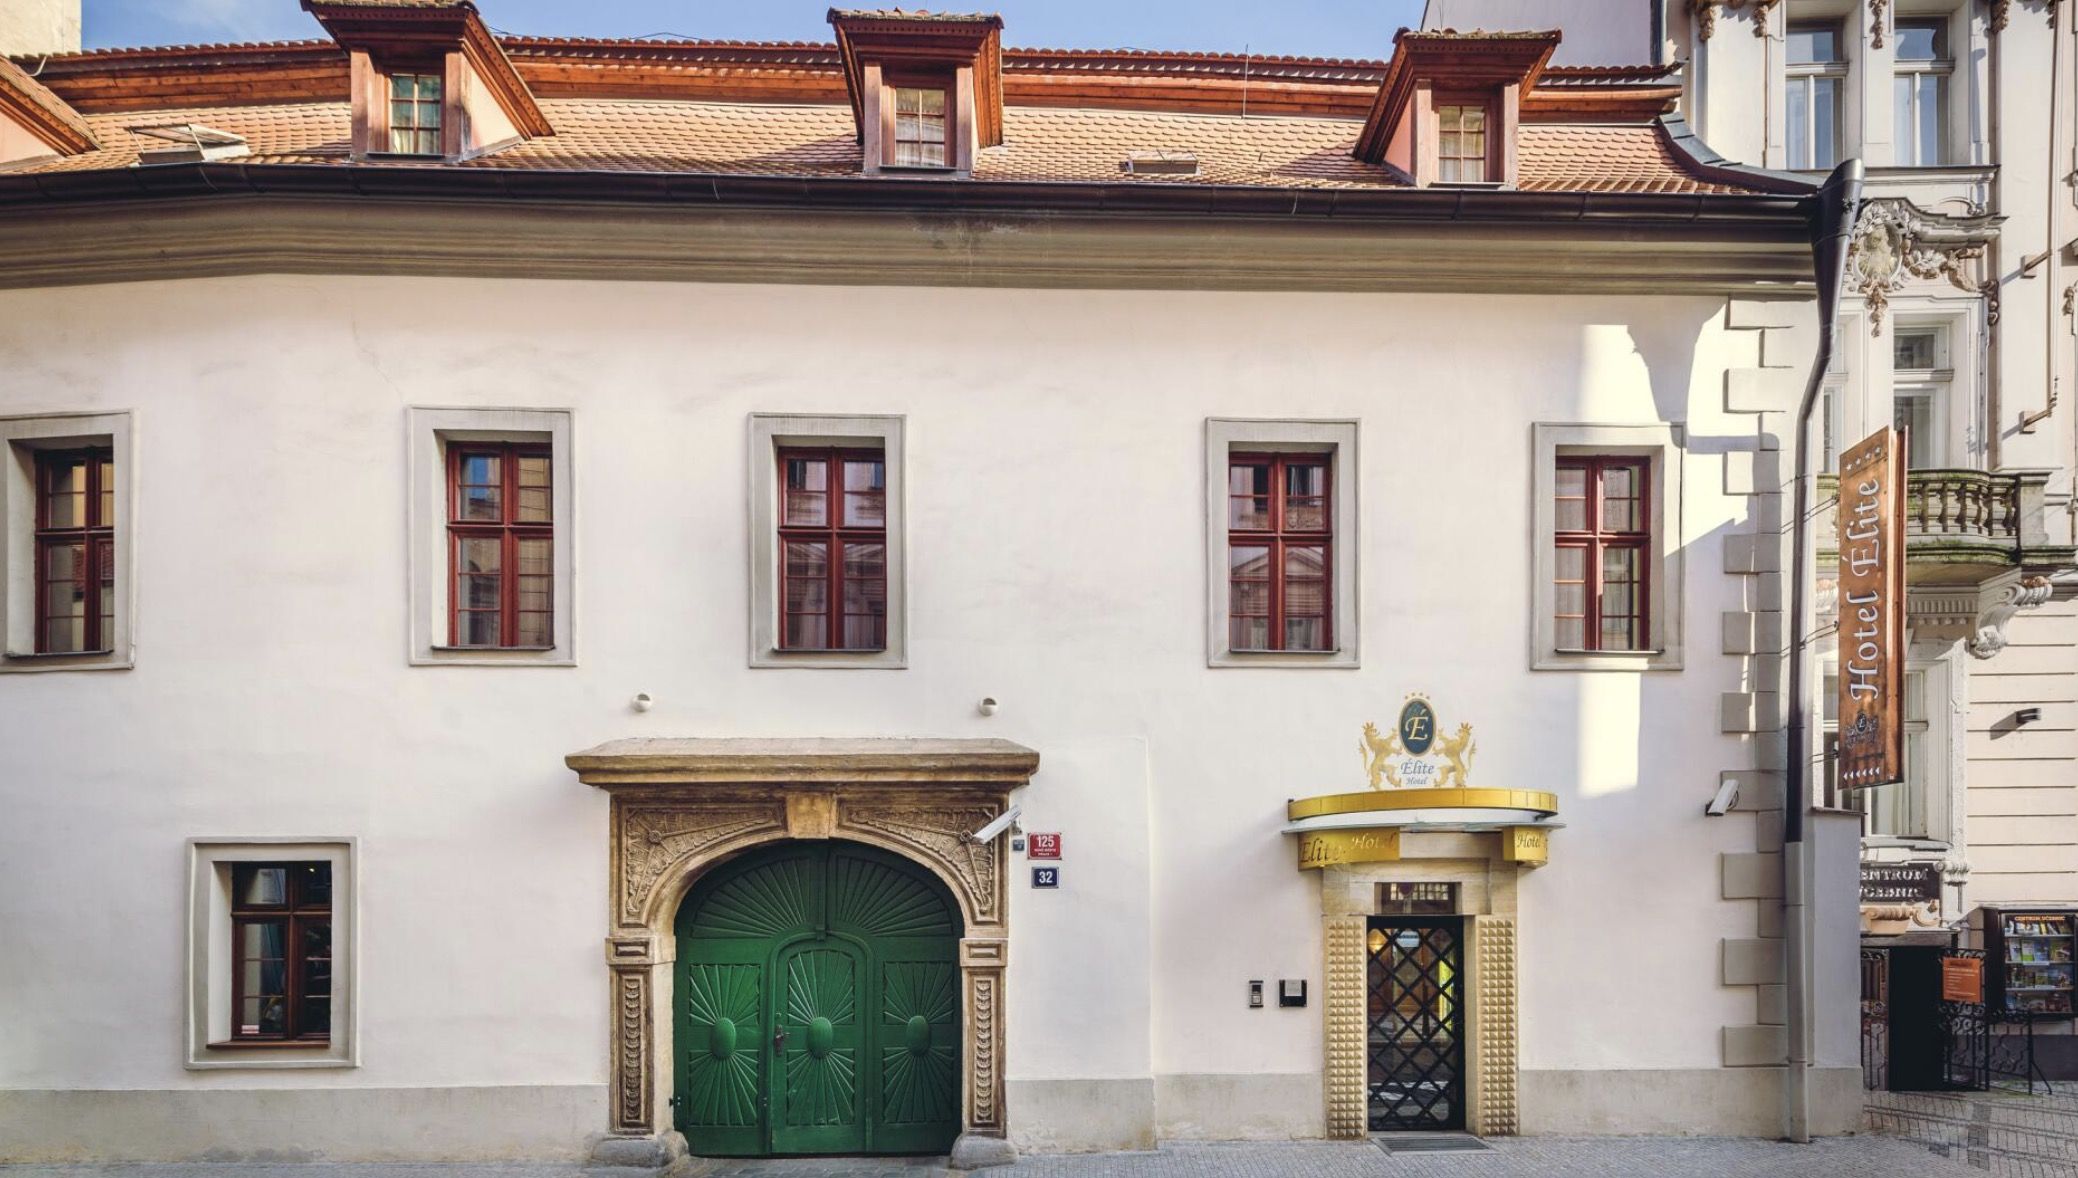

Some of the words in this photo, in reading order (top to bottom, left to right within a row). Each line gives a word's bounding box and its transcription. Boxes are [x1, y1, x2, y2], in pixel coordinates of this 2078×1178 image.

[1841, 478, 1880, 577] Élite
[1846, 590, 1879, 700] Hotel
[1400, 758, 1435, 775] Élite
[1036, 835, 1055, 847] 125
[1039, 871, 1053, 883] 32
[1860, 868, 1928, 880] ENTRUM
